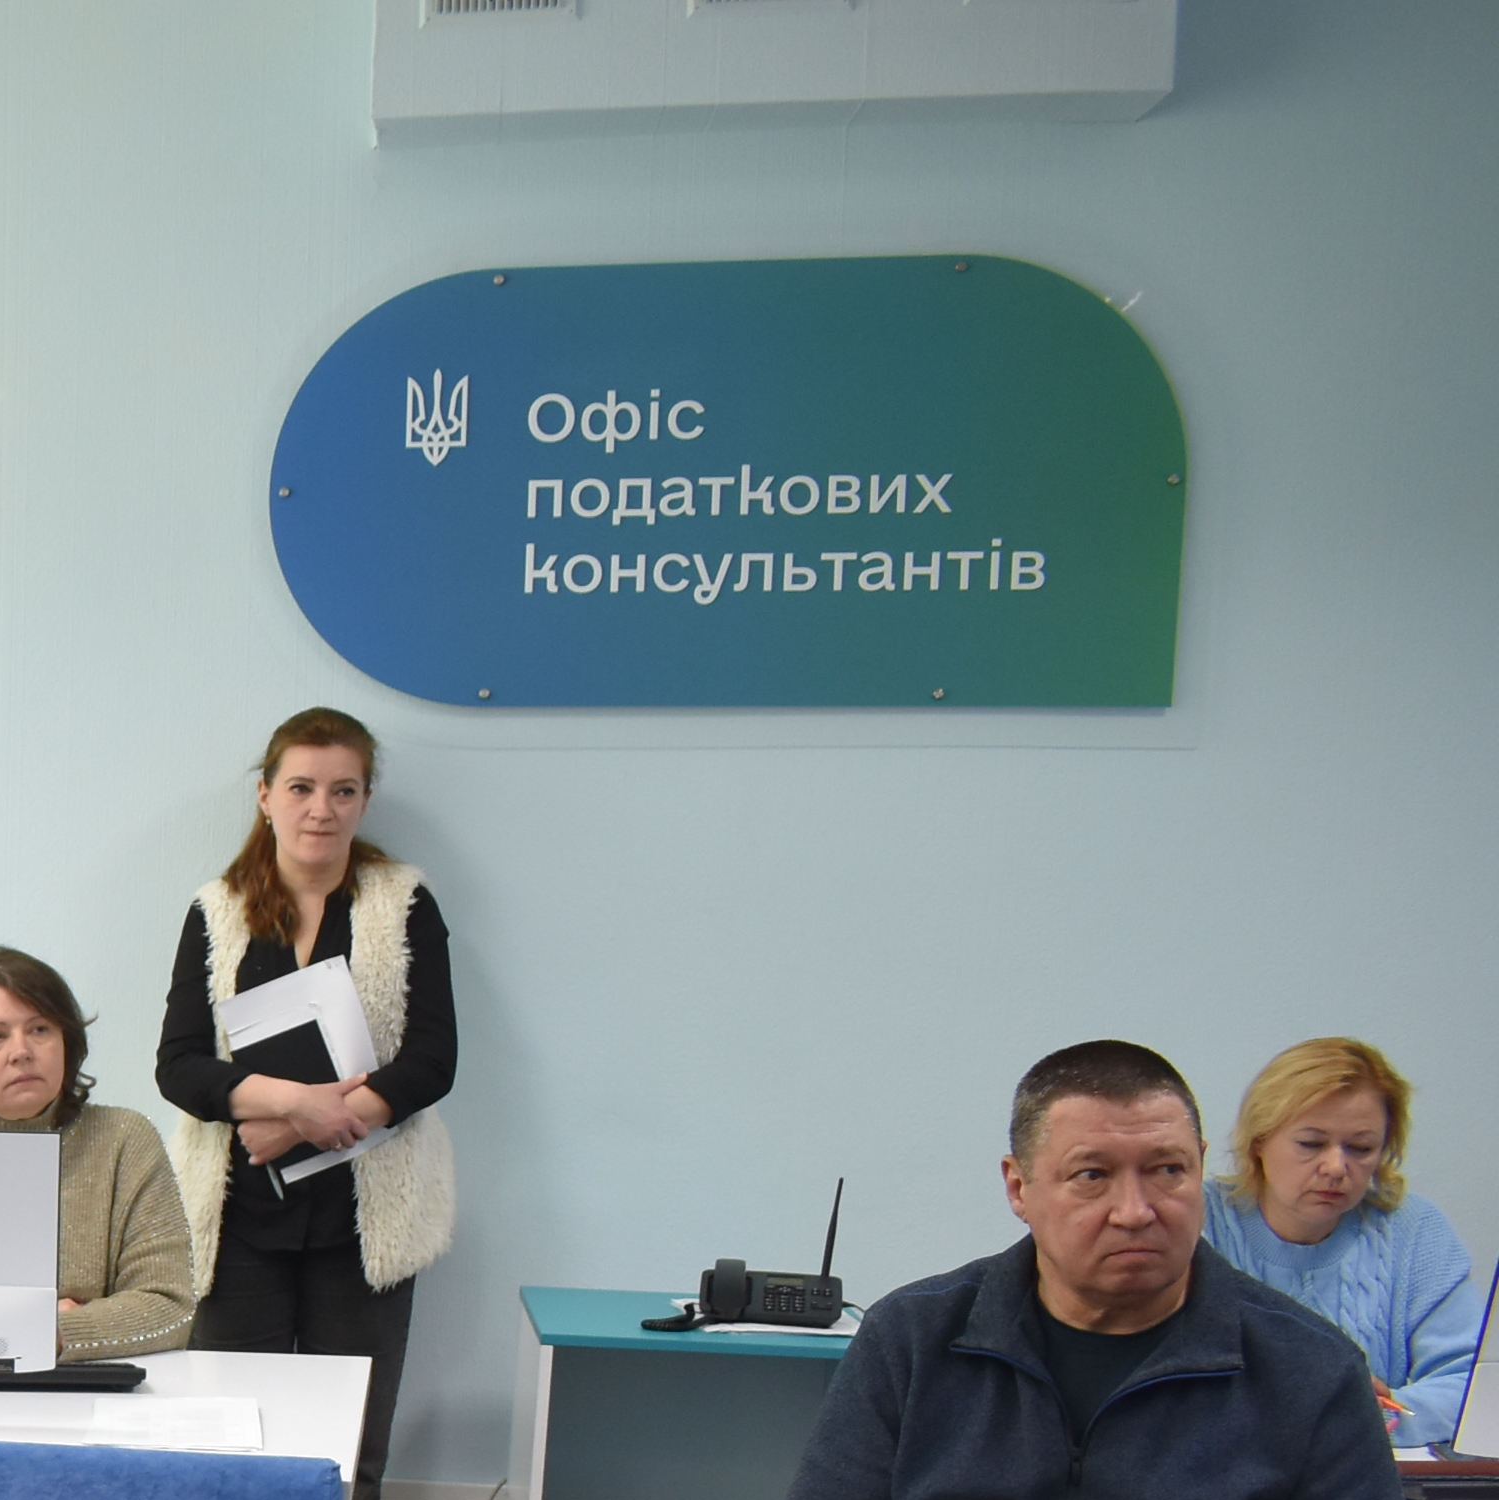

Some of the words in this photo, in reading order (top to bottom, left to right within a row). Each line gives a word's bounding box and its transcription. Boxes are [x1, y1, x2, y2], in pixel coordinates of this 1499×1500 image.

[527, 389, 705, 453] Офіс
[526, 464, 953, 526] податкових
[522, 537, 1047, 605] консультантів
